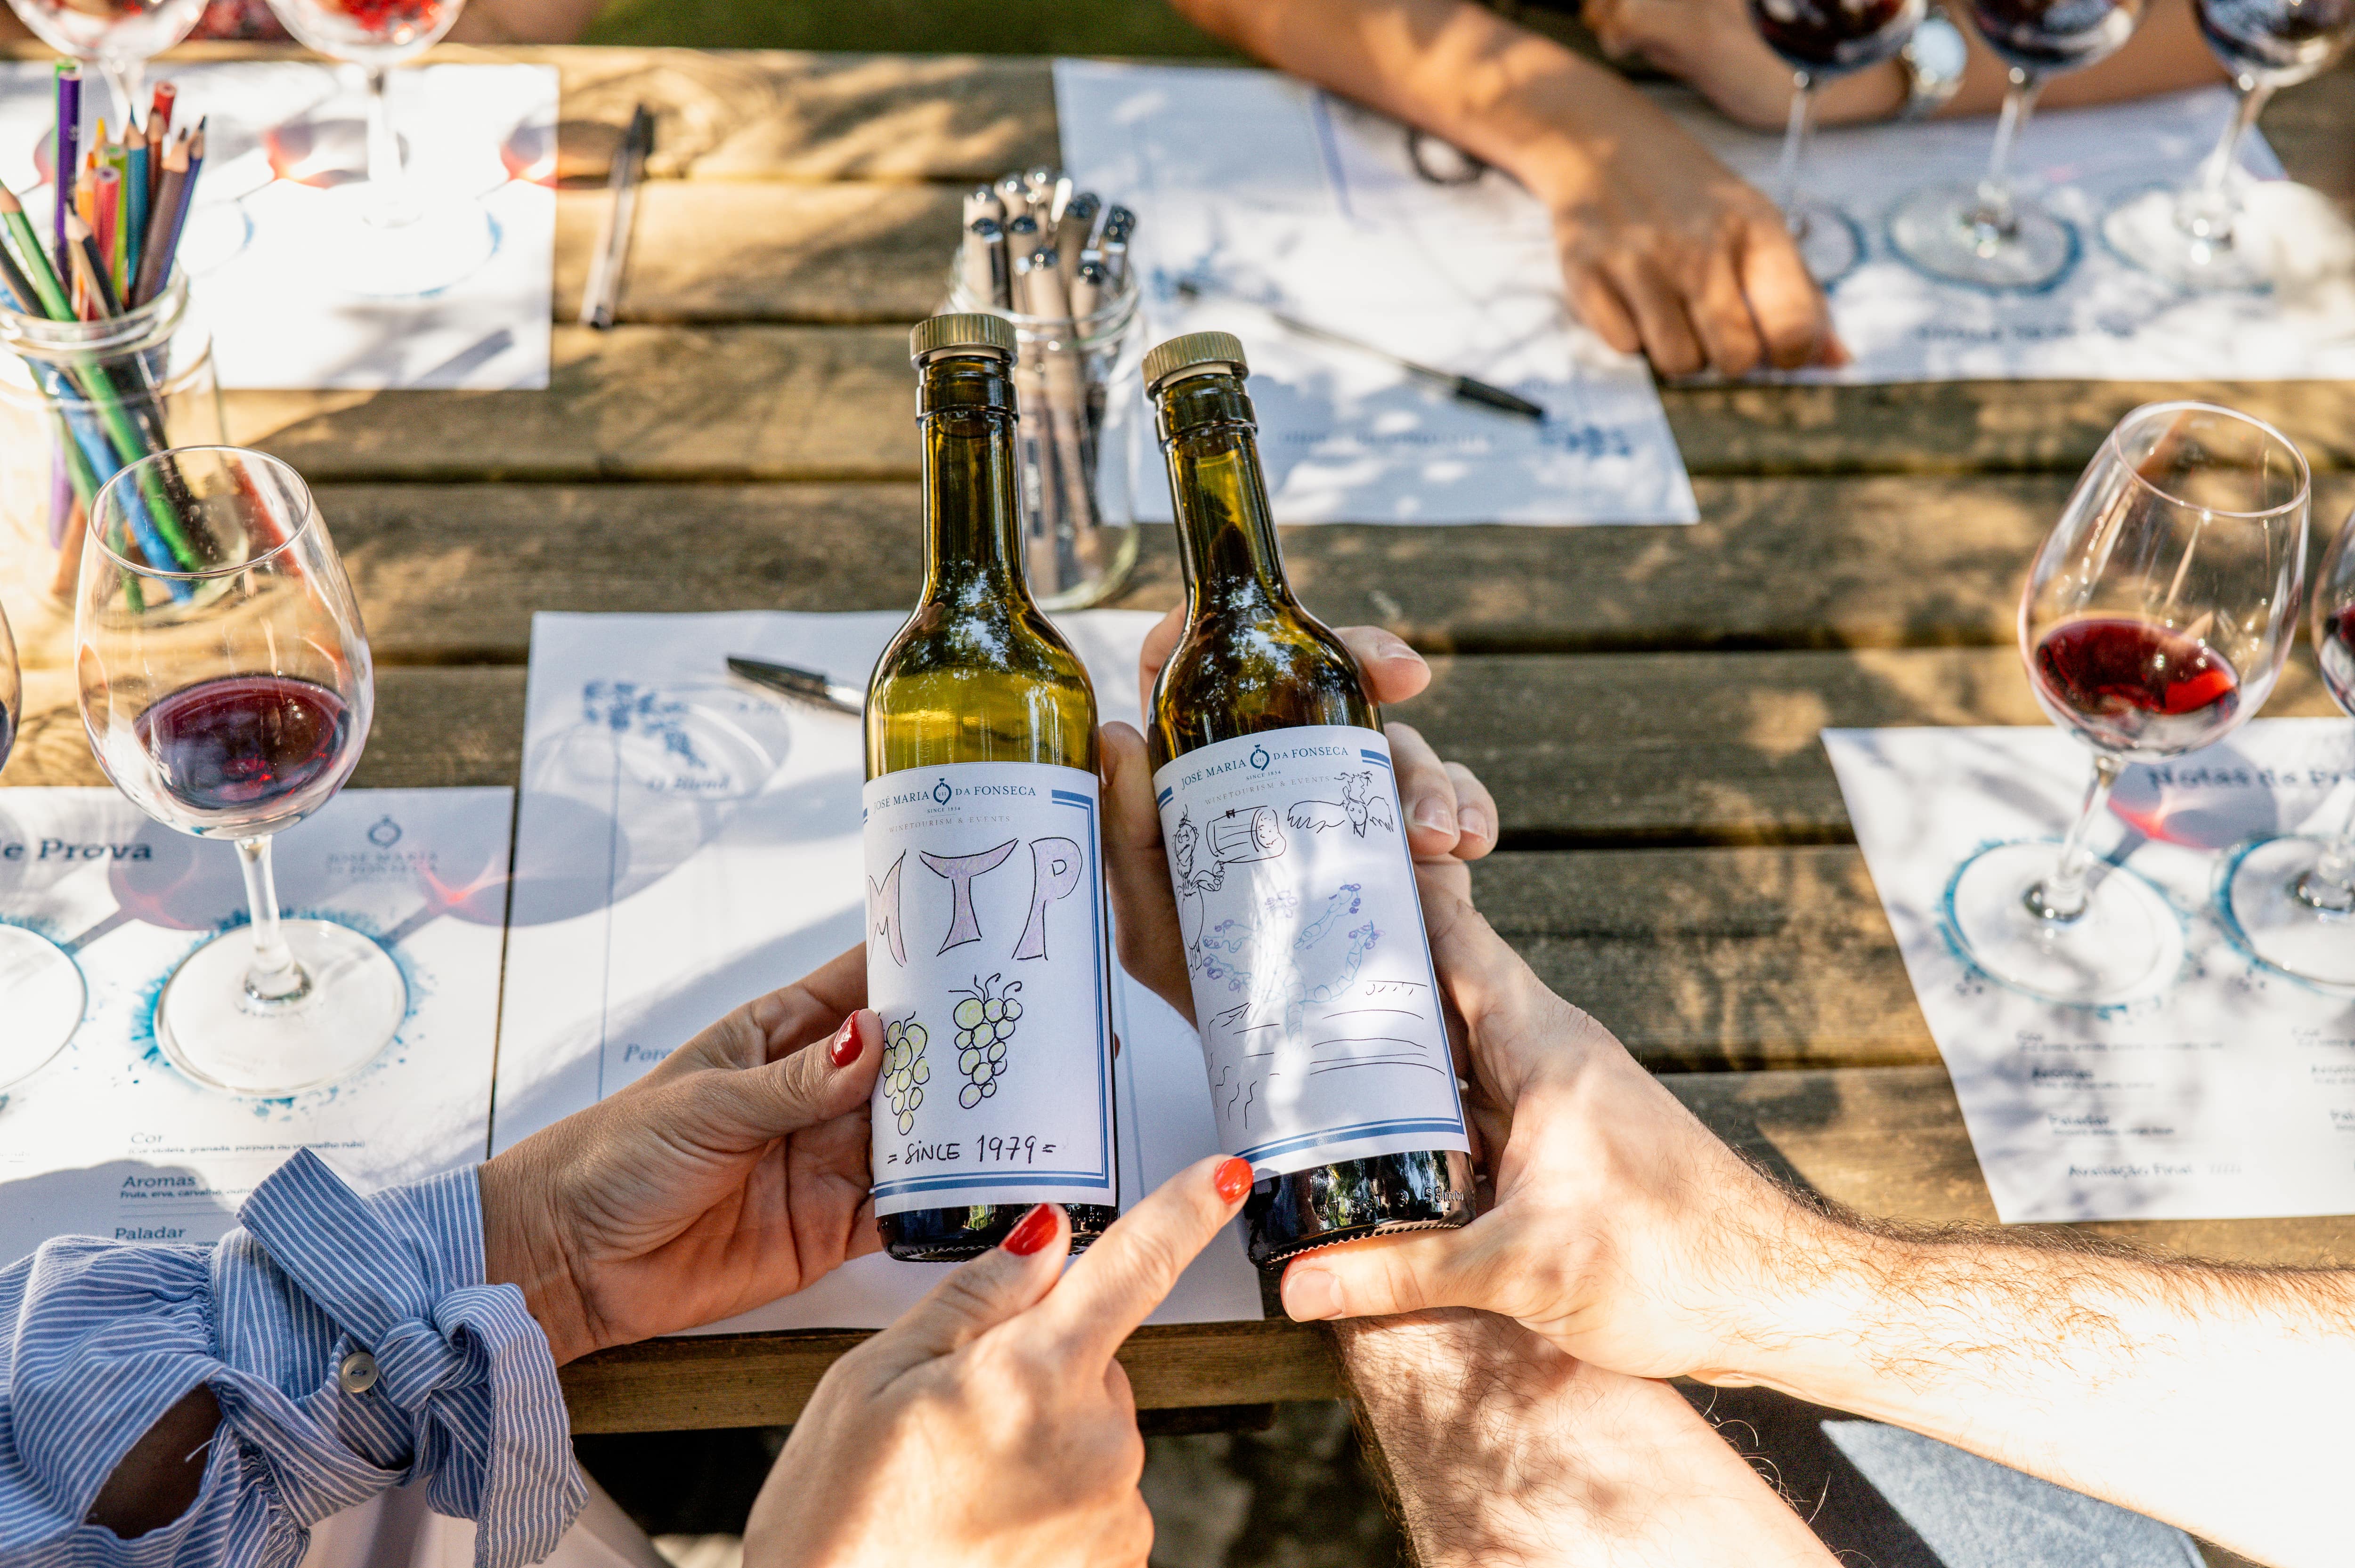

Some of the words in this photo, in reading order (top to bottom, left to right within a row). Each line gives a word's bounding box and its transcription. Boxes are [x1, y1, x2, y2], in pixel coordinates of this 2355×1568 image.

[1182, 769, 1202, 790] JOSÉ
[1206, 759, 1247, 777] MARIA
[1274, 752, 1289, 760] DA
[1291, 746, 1348, 758] FONSECA
[873, 796, 890, 814] JOSÉ
[893, 791, 929, 805] MARIA
[974, 785, 1036, 796] FONSECA
[1205, 783, 1274, 805] WINETOURISM
[1291, 776, 1330, 785] EVENTS
[889, 818, 952, 833] WINETOURISM
[38, 837, 151, 862] Prova
[131, 1132, 162, 1144] Cor
[976, 1134, 1037, 1164] 1979
[122, 1176, 196, 1188] Aromas
[115, 1226, 186, 1240] Paladar
